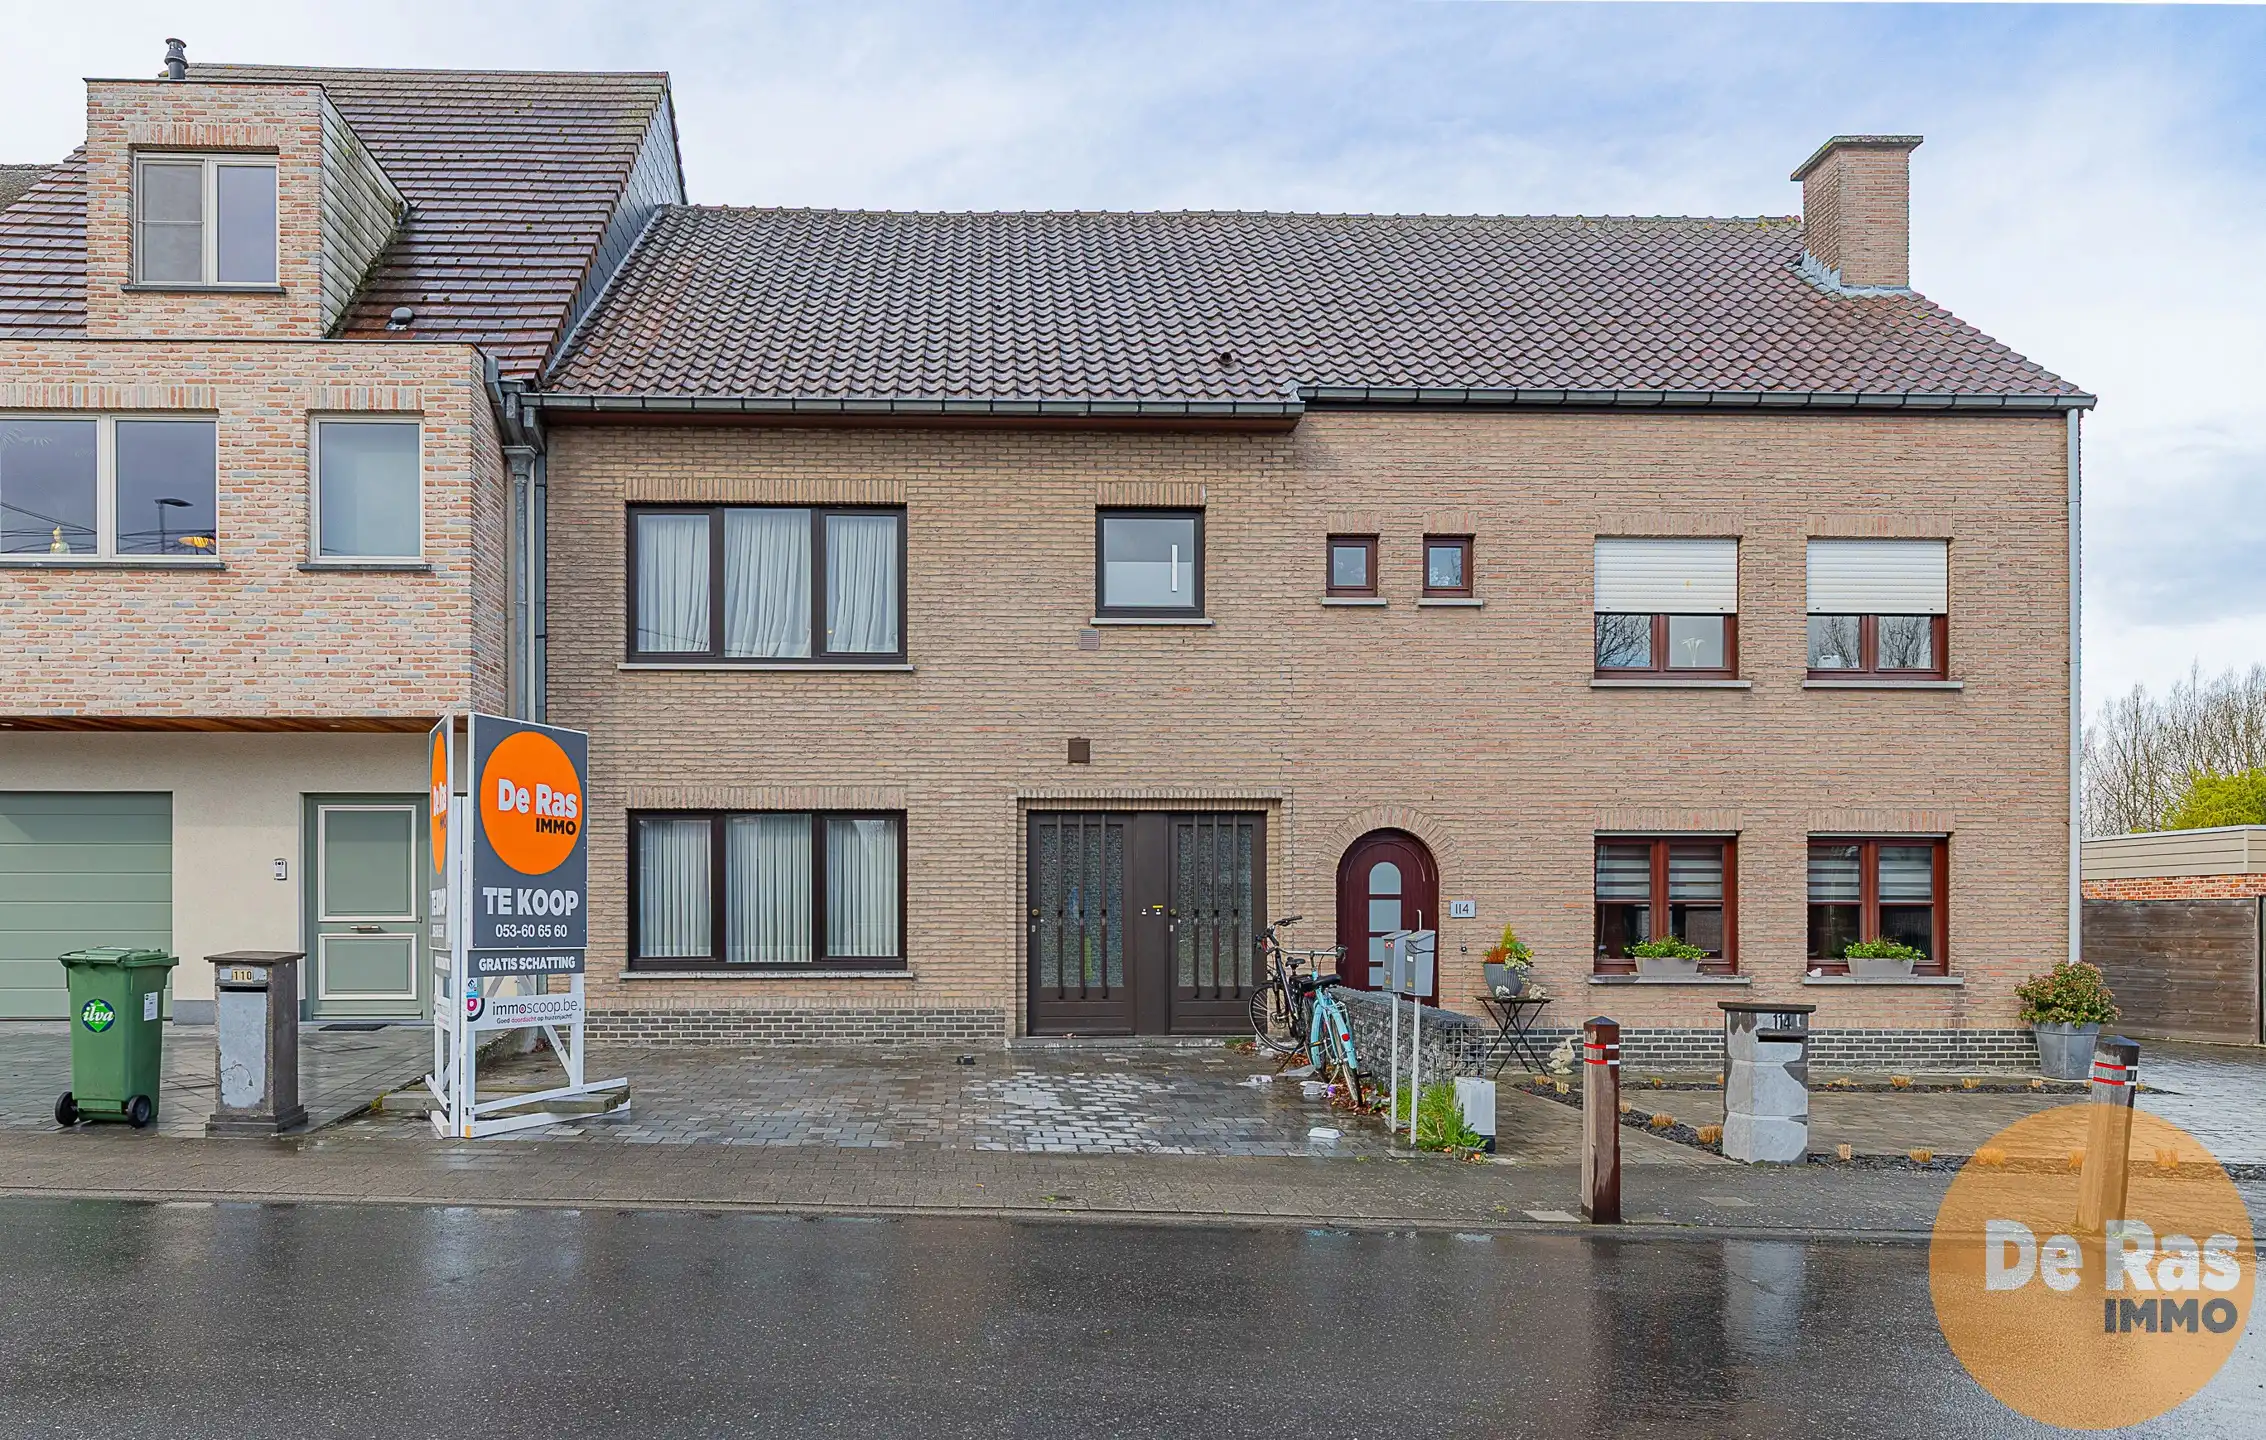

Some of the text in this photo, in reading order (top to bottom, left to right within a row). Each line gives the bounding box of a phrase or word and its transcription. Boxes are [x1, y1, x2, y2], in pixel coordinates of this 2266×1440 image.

[498, 778, 578, 819] De Ras
[535, 818, 577, 836] IMMO
[482, 887, 579, 916] TE KOOP
[1455, 904, 1469, 914] 114
[495, 924, 568, 938] 053-60 65 60
[478, 956, 576, 972] GRATIS SCHATTING
[234, 970, 252, 981] 110
[82, 1005, 114, 1022] ilva
[1773, 1013, 1791, 1029] 114
